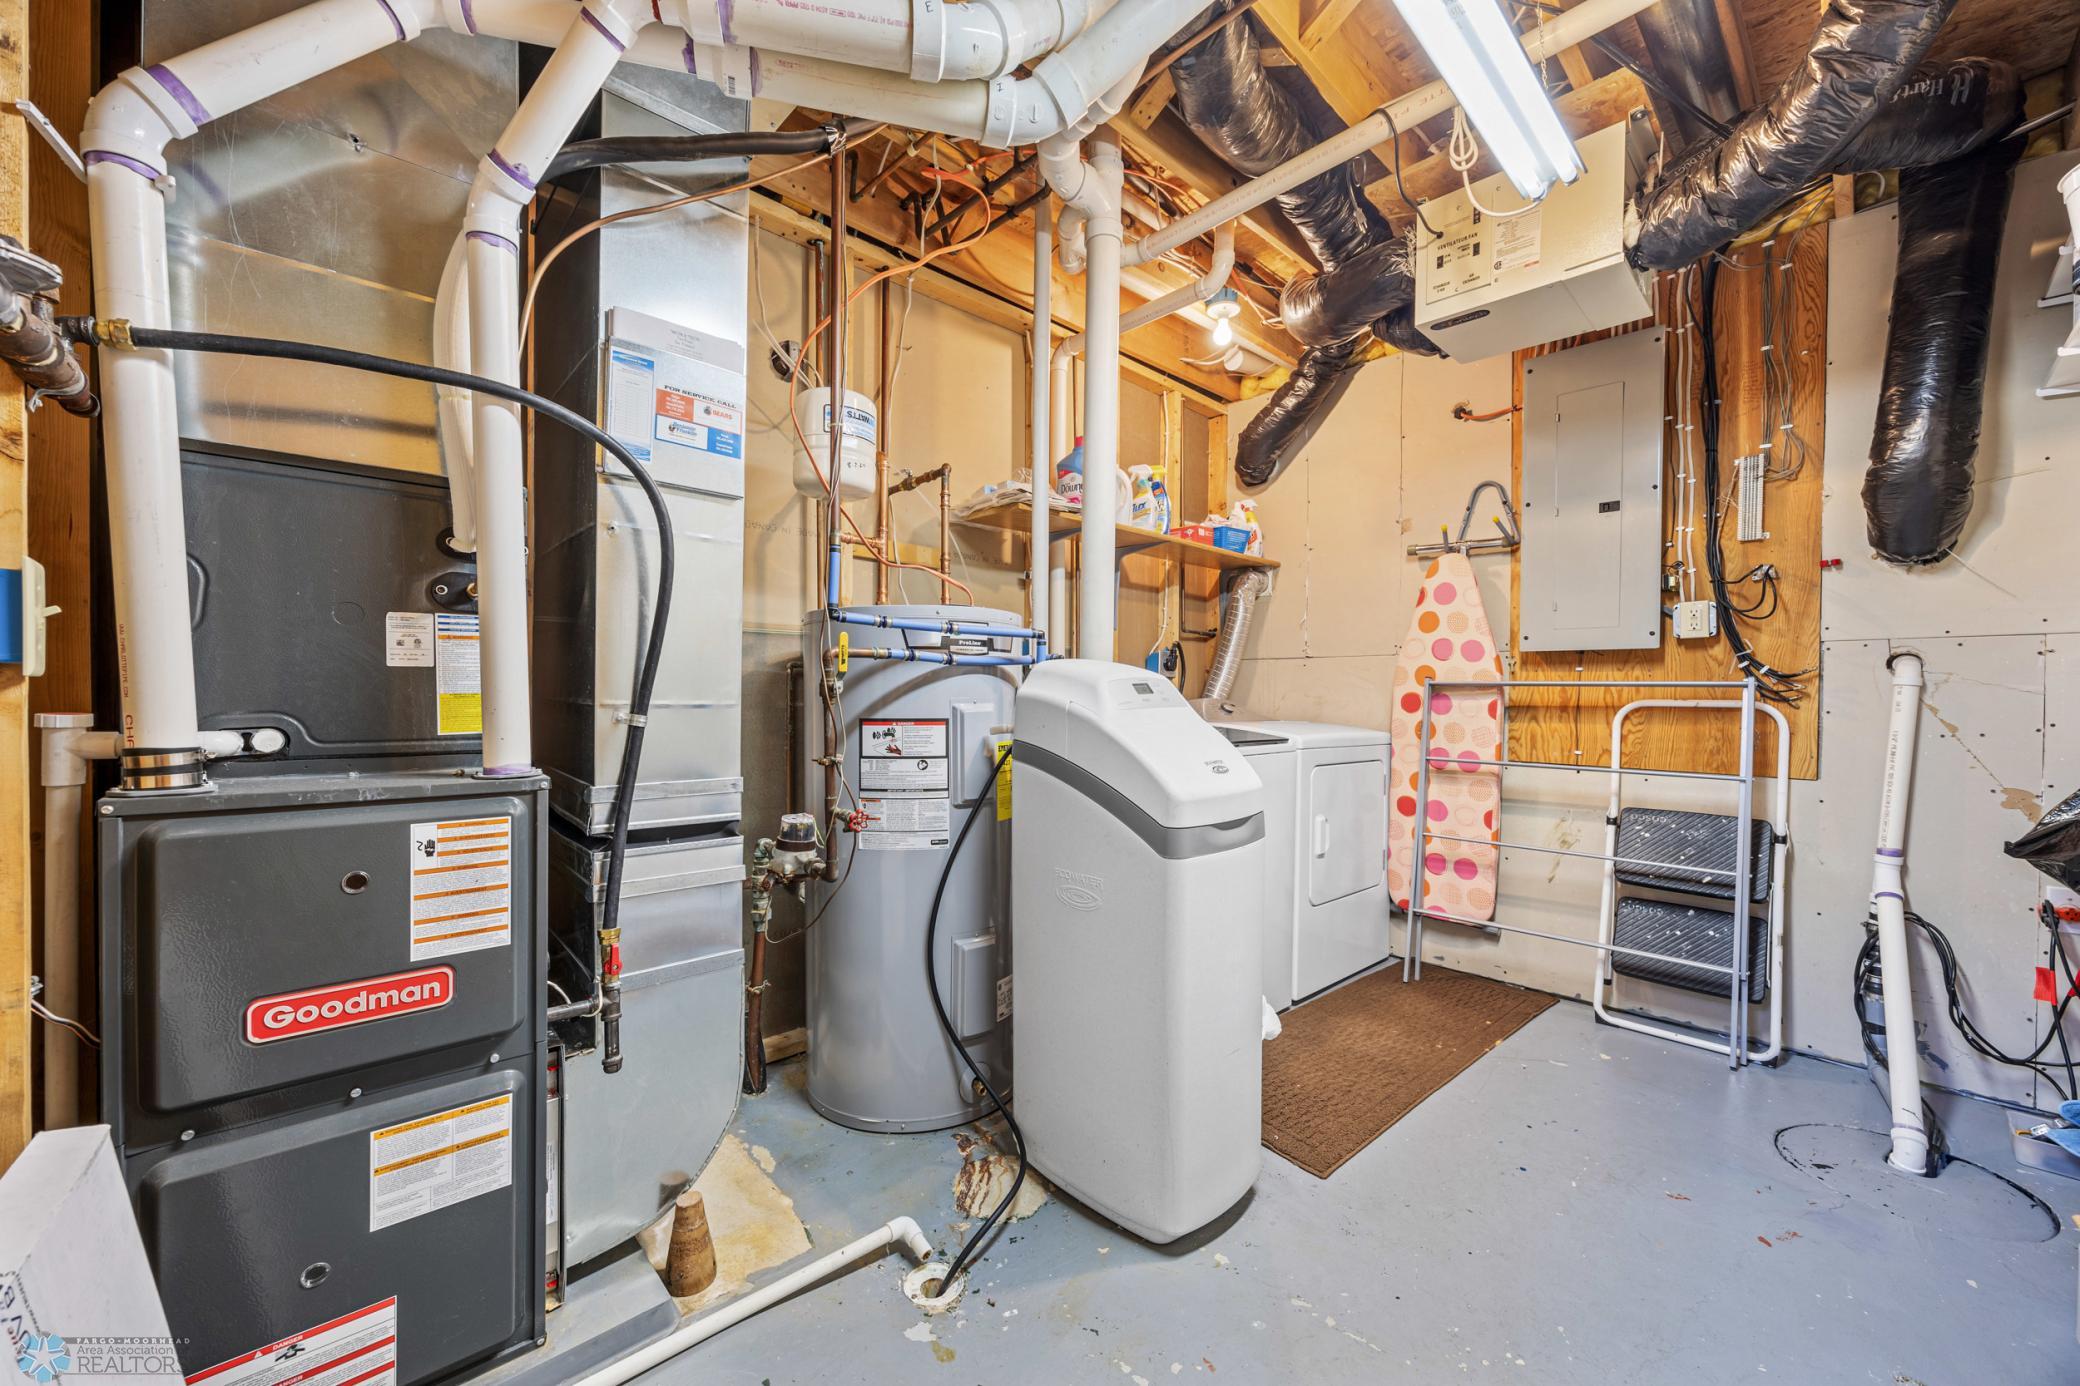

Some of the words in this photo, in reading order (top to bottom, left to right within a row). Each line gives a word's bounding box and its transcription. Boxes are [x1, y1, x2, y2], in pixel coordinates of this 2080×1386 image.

[664, 385, 680, 393] FOR
[682, 390, 716, 402] SERVICE
[717, 400, 737, 409] CALL
[712, 410, 733, 420] SEARS
[263, 981, 441, 1029] Goodman
[272, 1335, 304, 1351] DANGER
